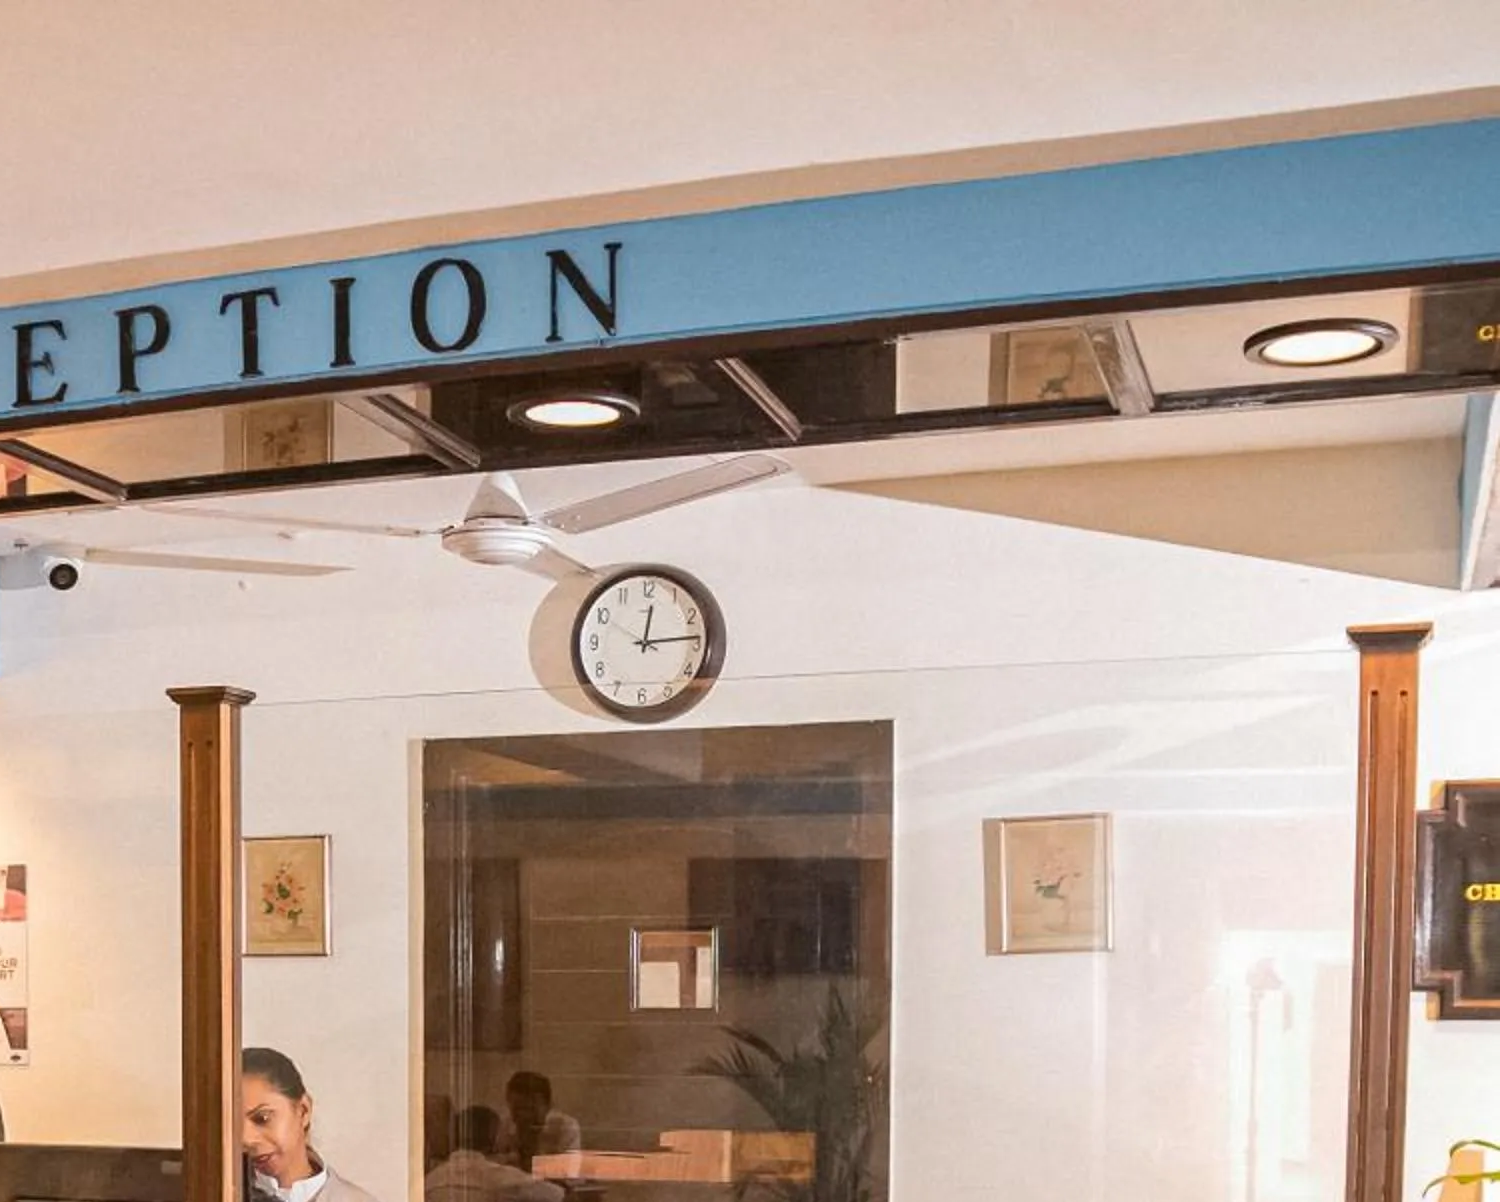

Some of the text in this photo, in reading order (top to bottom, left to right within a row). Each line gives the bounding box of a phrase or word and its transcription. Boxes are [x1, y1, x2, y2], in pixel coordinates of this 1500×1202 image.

[619, 587, 628, 605] 11
[643, 580, 655, 598] 12
[597, 607, 610, 625] 10
[687, 608, 697, 625] 2
[589, 634, 599, 651] 9
[692, 636, 701, 652] 3
[595, 661, 605, 678] 8
[683, 663, 693, 678] 4
[612, 681, 622, 697] 7
[637, 688, 647, 705] 6
[663, 681, 673, 698] 5
